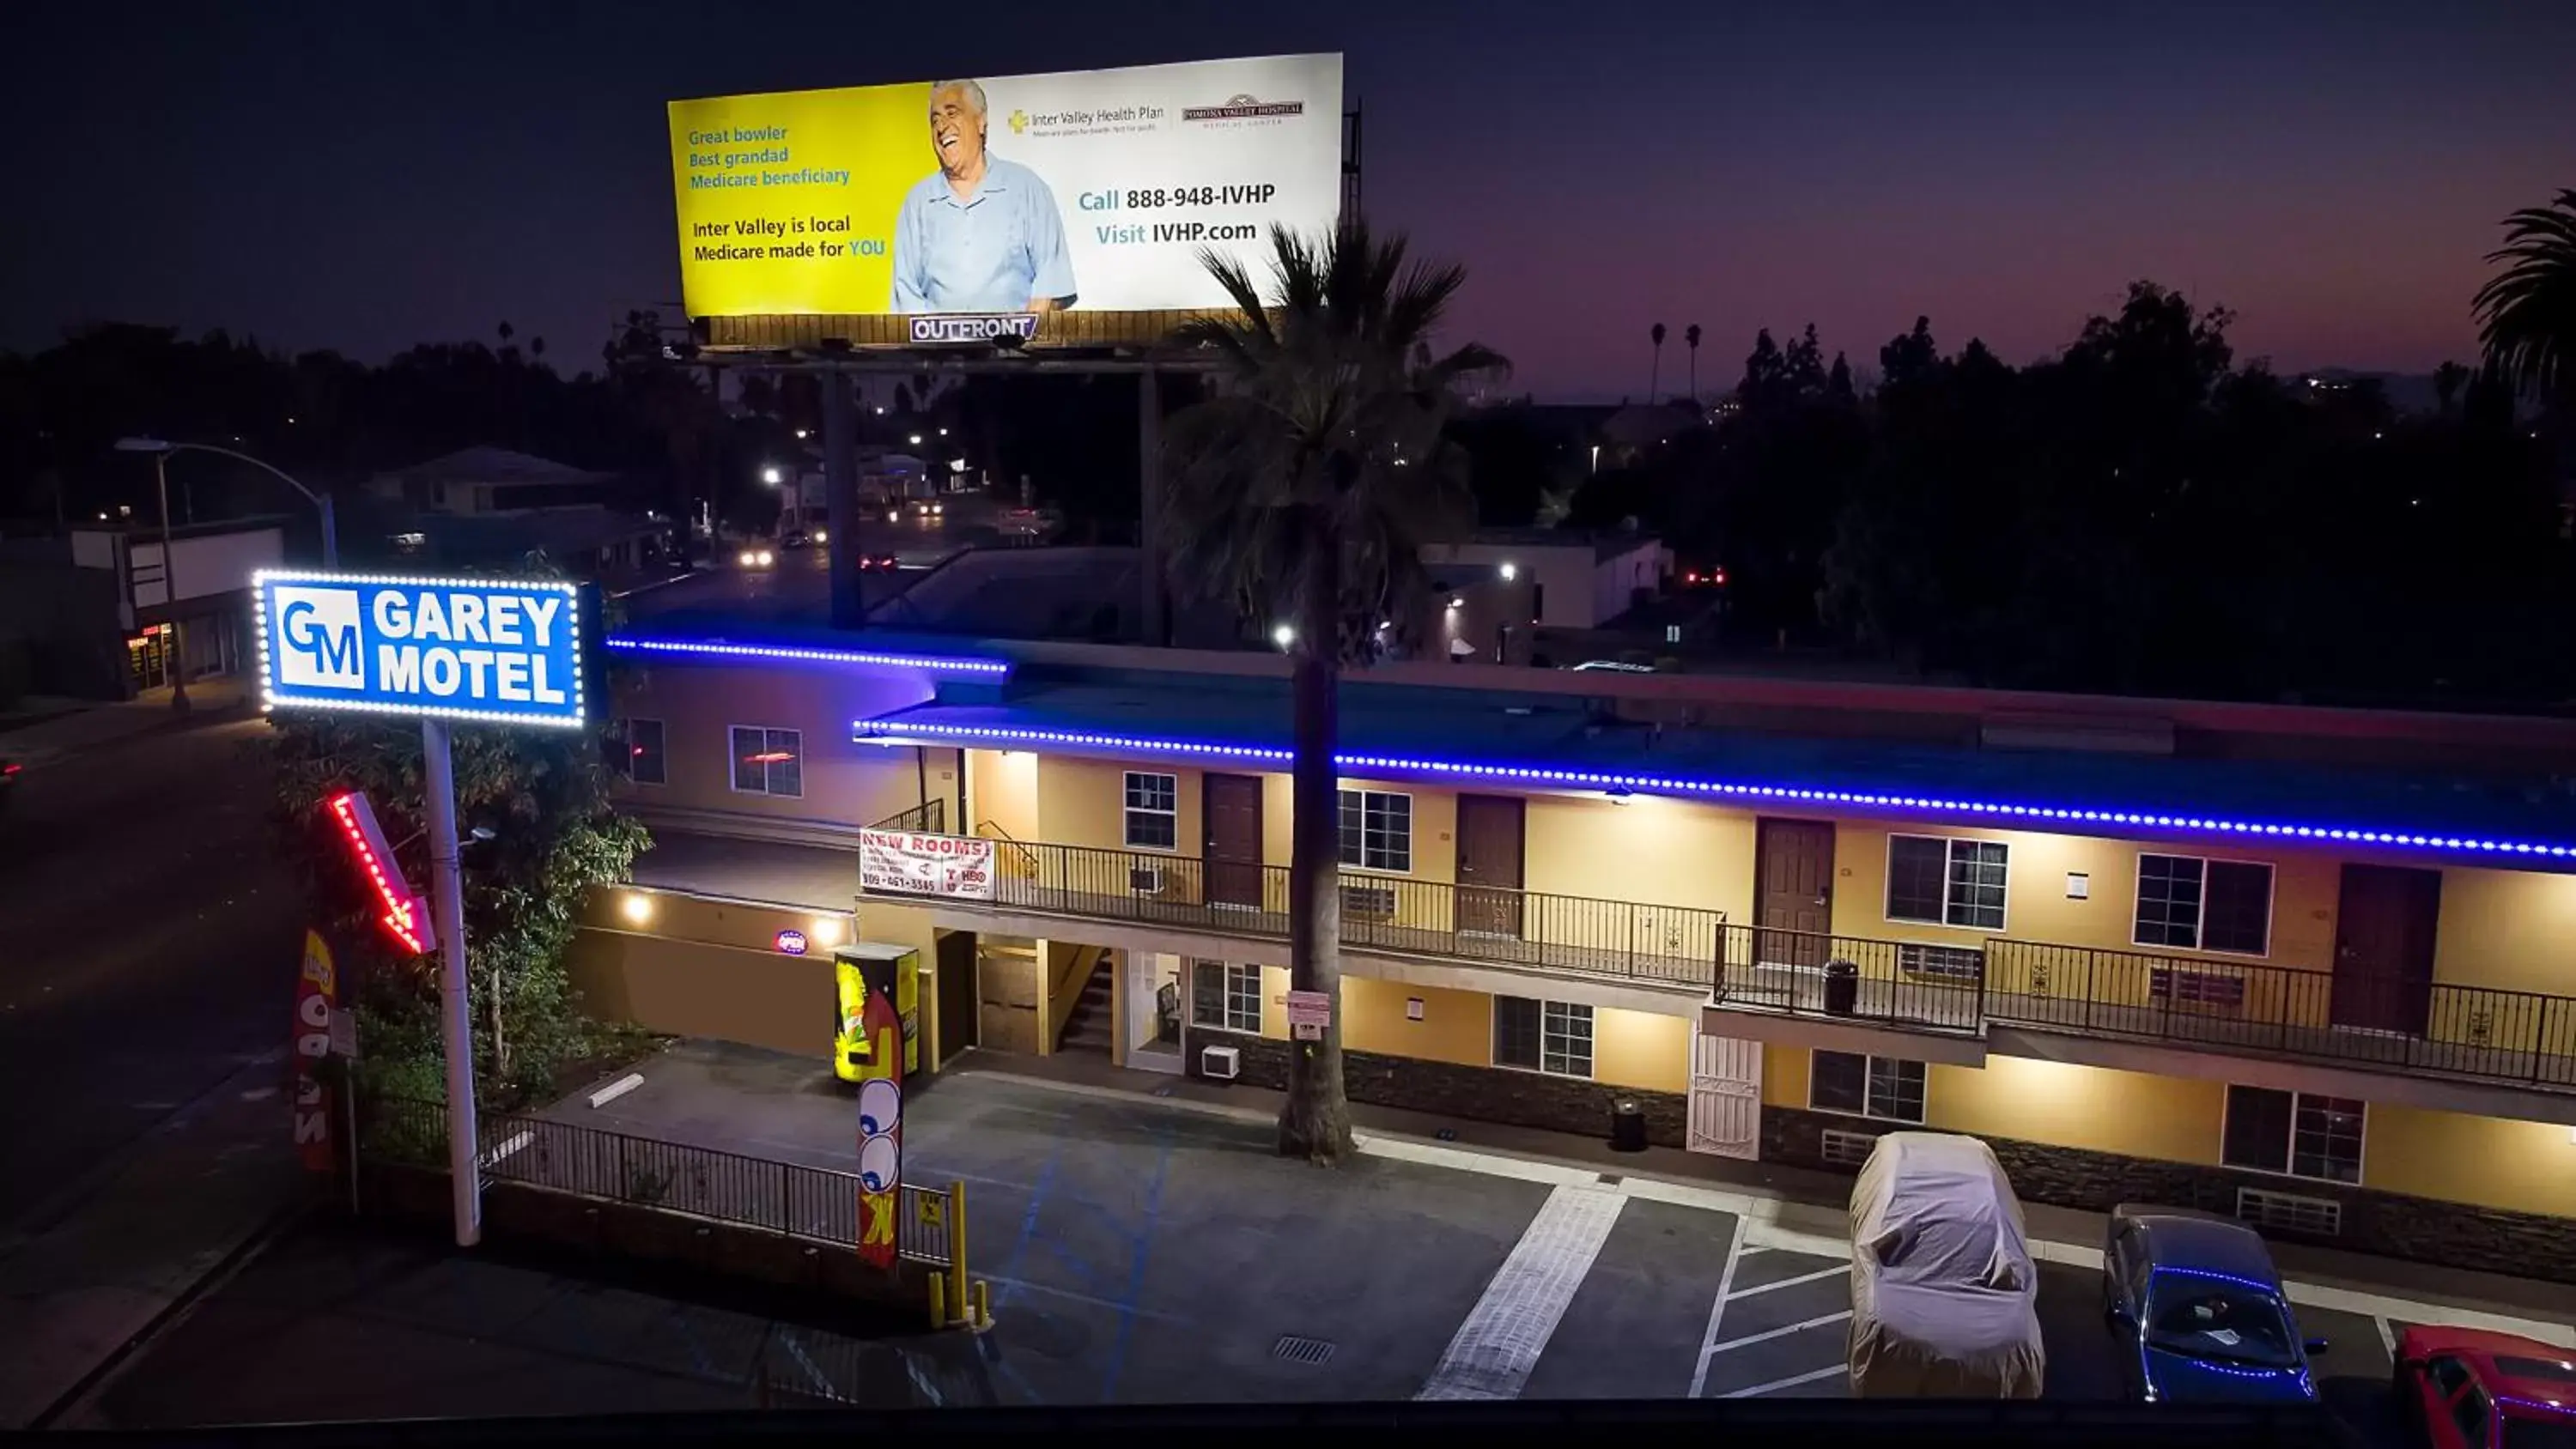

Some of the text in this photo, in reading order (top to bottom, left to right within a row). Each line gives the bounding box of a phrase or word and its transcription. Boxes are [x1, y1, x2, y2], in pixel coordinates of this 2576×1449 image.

[1032, 105, 1164, 126] Inter Valley Health Plan
[689, 126, 787, 145] Great bowler
[690, 148, 788, 169] Best grandad
[690, 168, 850, 190] Medicare beneficiary
[1078, 184, 1275, 211] Call 888-948-IVHP
[693, 215, 851, 238] Inter Valley is local
[1096, 221, 1256, 245] Visit IVHP.com
[694, 239, 886, 261] Medicare made for YOU
[914, 318, 1031, 339] OUTFRONT
[373, 590, 562, 647] GAREY
[283, 600, 360, 676] GM
[378, 644, 566, 705] MOTEL
[862, 833, 903, 850] NEW
